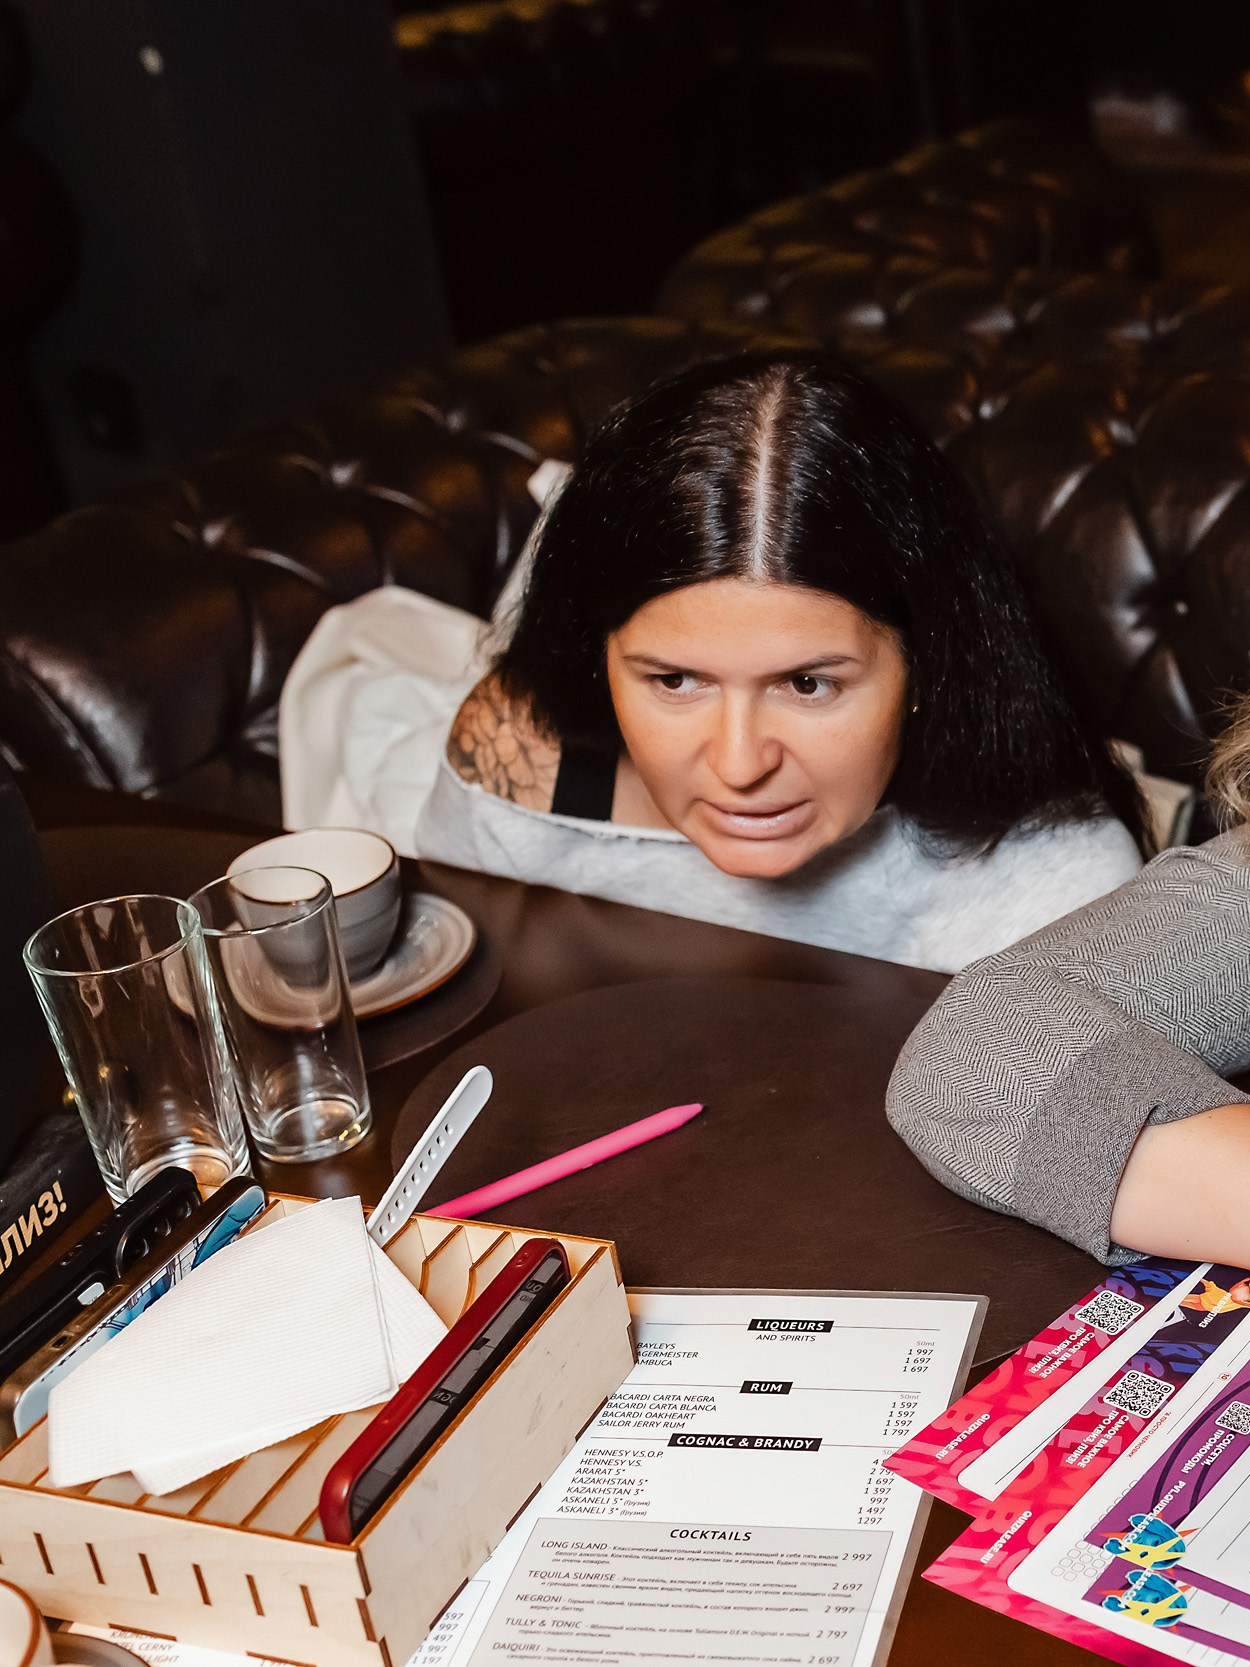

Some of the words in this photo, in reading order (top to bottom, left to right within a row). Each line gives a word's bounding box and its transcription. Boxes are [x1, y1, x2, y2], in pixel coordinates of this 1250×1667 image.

[0, 1181, 67, 1275] ЛИЗ!
[756, 1321, 825, 1331] LIQUEURS
[1069, 1327, 1086, 1341] ПРО
[637, 1342, 676, 1350] BAYLEYS
[1049, 1340, 1072, 1356] КВИЗ,
[1069, 1332, 1095, 1355] САМОЕ
[1029, 1355, 1052, 1374] ПЛИЗ!
[1039, 1353, 1072, 1379] ВАЖНОЕ
[750, 1383, 783, 1393] RUM
[610, 1393, 651, 1401] BACARDI
[653, 1394, 681, 1402] CARTA
[606, 1402, 647, 1410] BACARDI
[680, 1404, 717, 1412] BLANCA
[645, 1412, 696, 1420] OAKHEART
[1102, 1410, 1119, 1425] ПРО
[632, 1420, 661, 1428] JERRY
[663, 1421, 685, 1429] RUM
[1103, 1415, 1129, 1440] САМОЕ
[934, 1413, 991, 1460] QUIZPLEASE.RU
[1083, 1424, 1106, 1443] КВИЗ,
[676, 1436, 736, 1447] COGNAC
[738, 1438, 750, 1447] &
[754, 1438, 814, 1450] BRANDY
[1201, 1433, 1235, 1466] СОЦСЕТИ,
[584, 1449, 631, 1457] HENNESY
[1066, 1442, 1088, 1465] ПЛИЗ!
[1077, 1438, 1109, 1468] ВАЖНОЕ
[1181, 1429, 1225, 1474] ПРОМОКОДЫ
[580, 1458, 626, 1466] HENNESY
[575, 1468, 613, 1476] ARARAT
[571, 1477, 635, 1486] KAZAKHSTAN
[567, 1487, 631, 1496] KAZAKHSTAN
[561, 1496, 610, 1505] ASKANELI
[557, 1506, 606, 1515] ASKANELI
[1118, 1480, 1187, 1552] PVL.QUIZPLEASE.COM
[670, 1529, 751, 1542] COCKTAILS
[980, 1510, 1033, 1564] QUIZPLEASE.RU
[541, 1541, 569, 1549] LONG
[571, 1542, 608, 1550] ISLAND
[842, 1553, 848, 1561] 2
[852, 1553, 872, 1562] 997
[528, 1570, 570, 1579] TEQUILA
[573, 1572, 616, 1581] SUNRISE
[842, 1583, 862, 1591] 697
[516, 1594, 562, 1603] NEGRONI
[824, 1605, 831, 1613] 2
[835, 1606, 855, 1614] 997
[505, 1617, 536, 1626] TULLY
[551, 1620, 582, 1628] TONIC
[816, 1630, 823, 1638] 2
[827, 1631, 847, 1639] 797
[138, 1643, 173, 1651] CERNY
[492, 1642, 540, 1651] DAIQUIRI
[818, 1656, 840, 1664] 697
